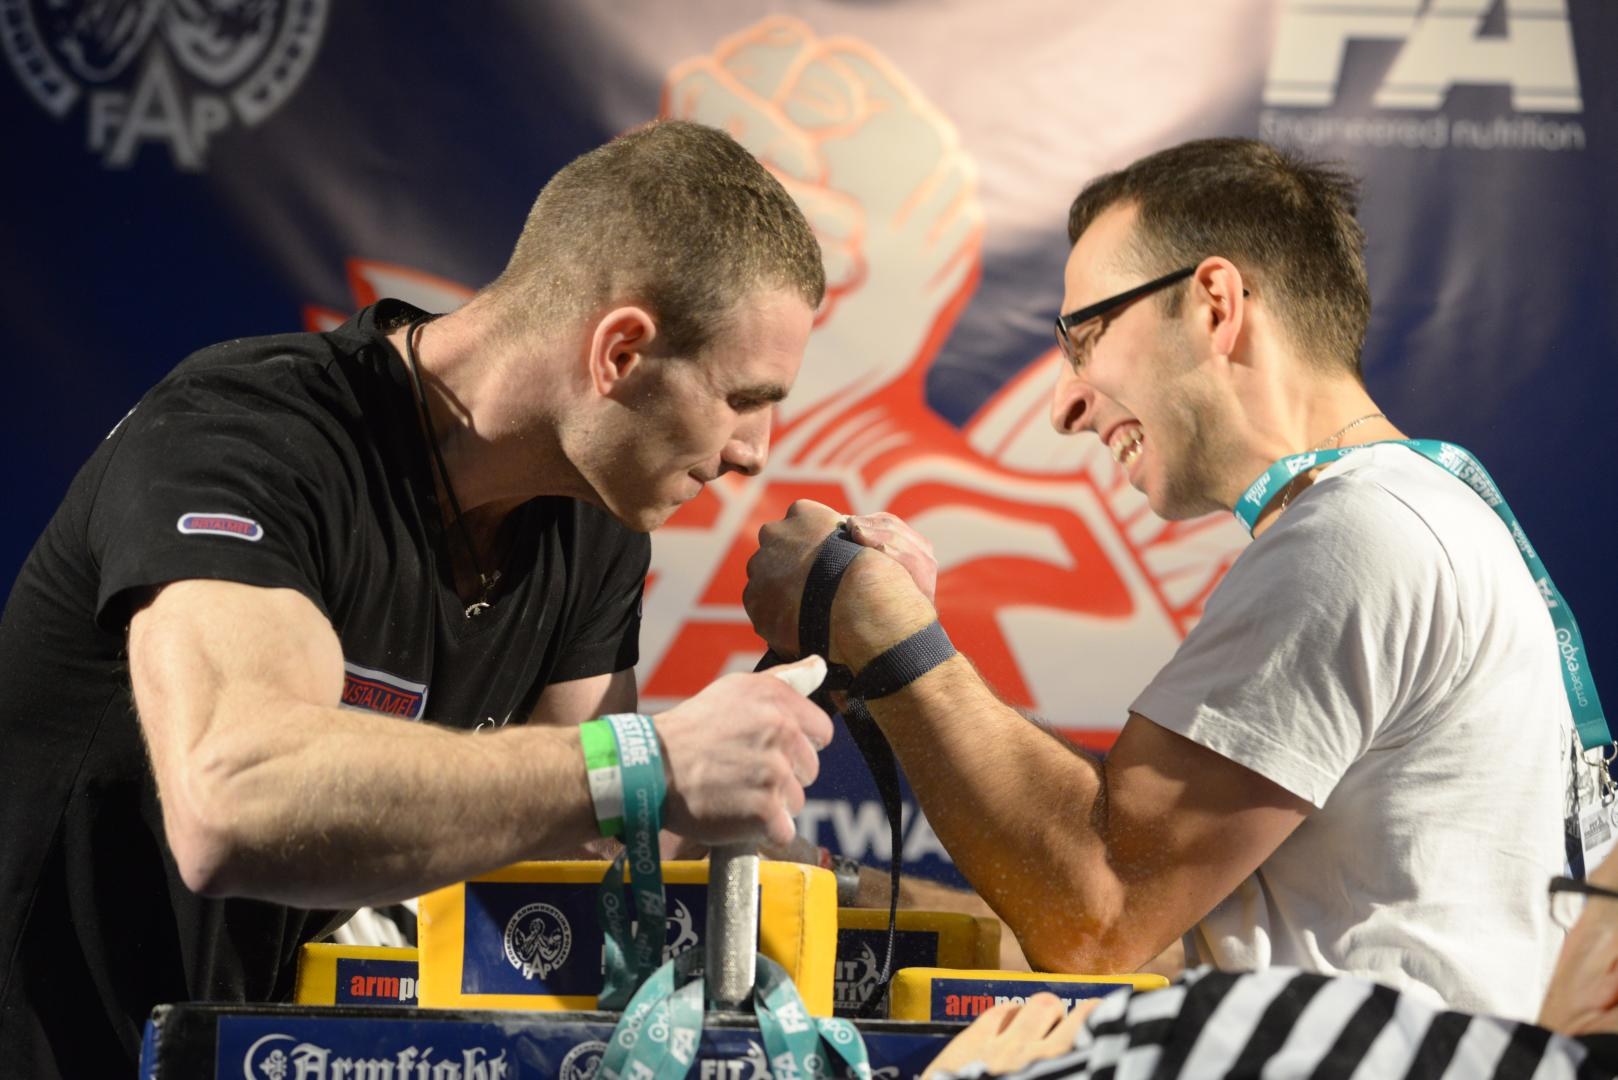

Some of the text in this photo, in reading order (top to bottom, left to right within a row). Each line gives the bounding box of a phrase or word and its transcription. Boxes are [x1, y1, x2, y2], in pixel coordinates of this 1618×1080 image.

[88, 45, 231, 169] FAP
[1452, 117, 1586, 150] nutrition
[343, 680, 416, 717] NSTALMET
[522, 950, 552, 980] FAP
